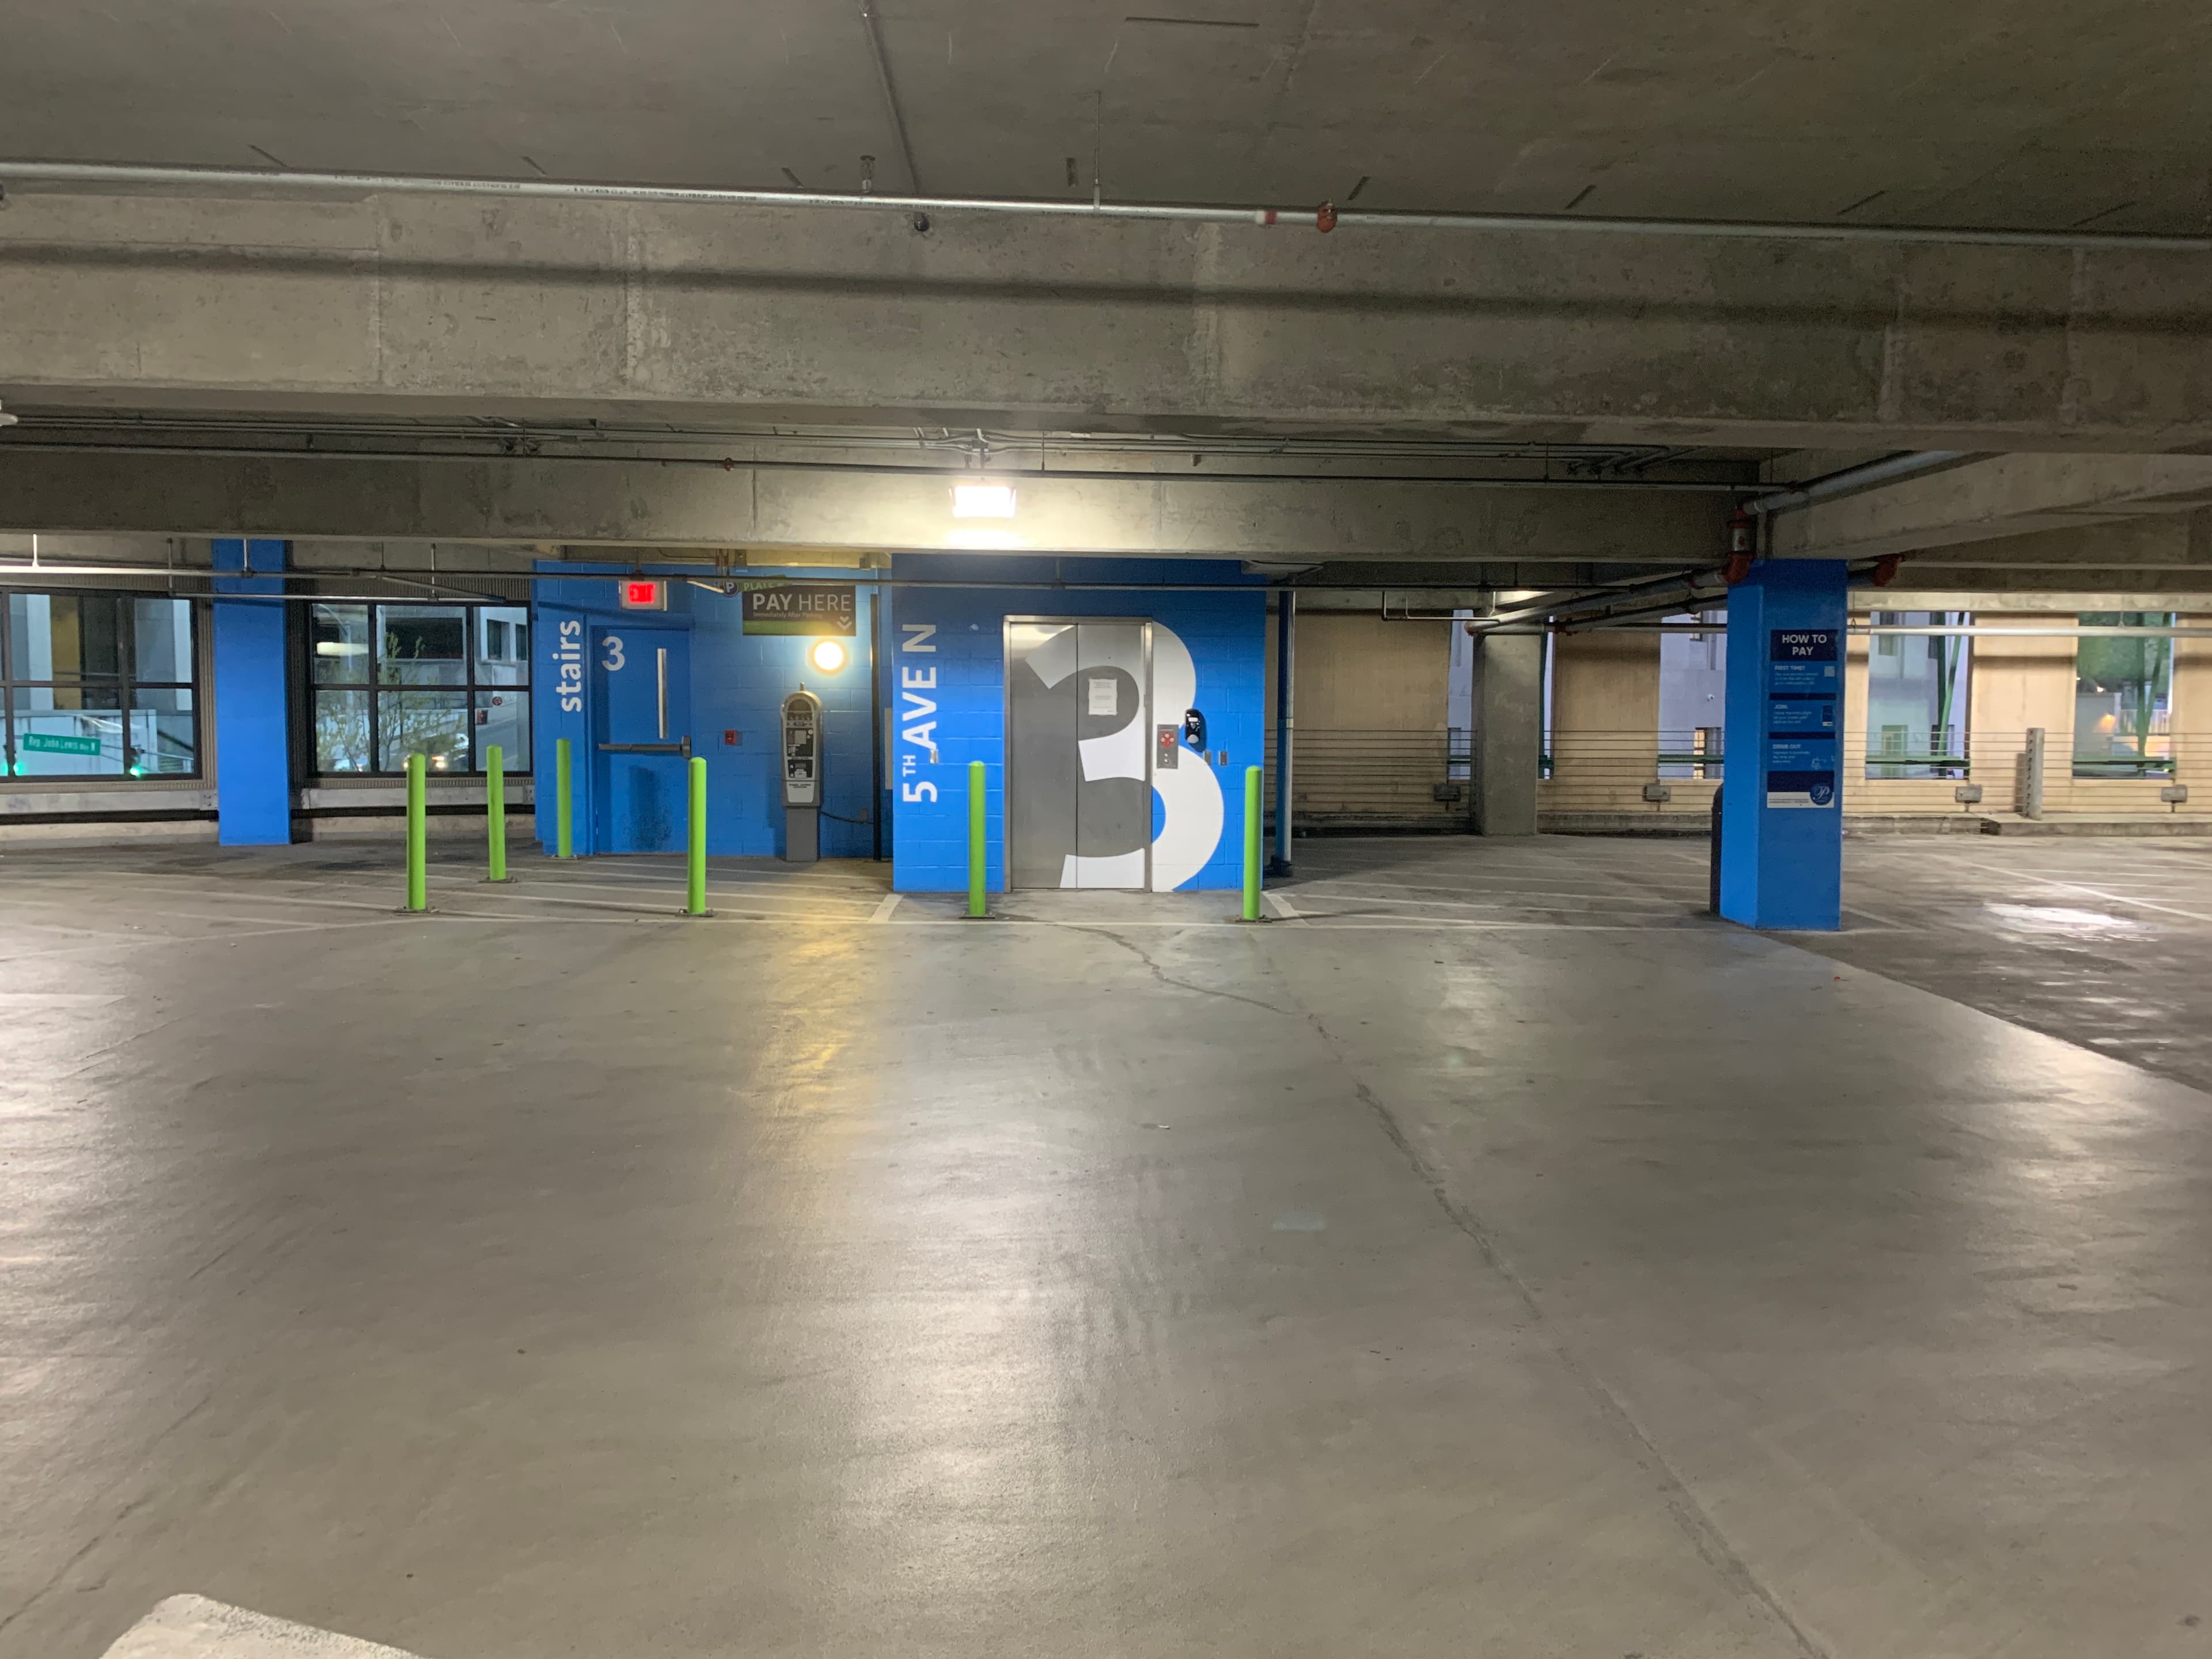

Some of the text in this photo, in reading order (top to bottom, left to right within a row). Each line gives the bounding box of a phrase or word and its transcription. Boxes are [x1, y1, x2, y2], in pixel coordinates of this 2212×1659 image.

[629, 583, 655, 604] EXIT
[753, 593, 851, 612] PAY HERE
[902, 624, 936, 652] N
[1782, 634, 1827, 643] HOW TO
[1792, 646, 1814, 656] PAY
[552, 620, 582, 712] stairs
[602, 636, 625, 671] 3
[902, 666, 937, 750] AVE
[1025, 620, 1224, 892] 3
